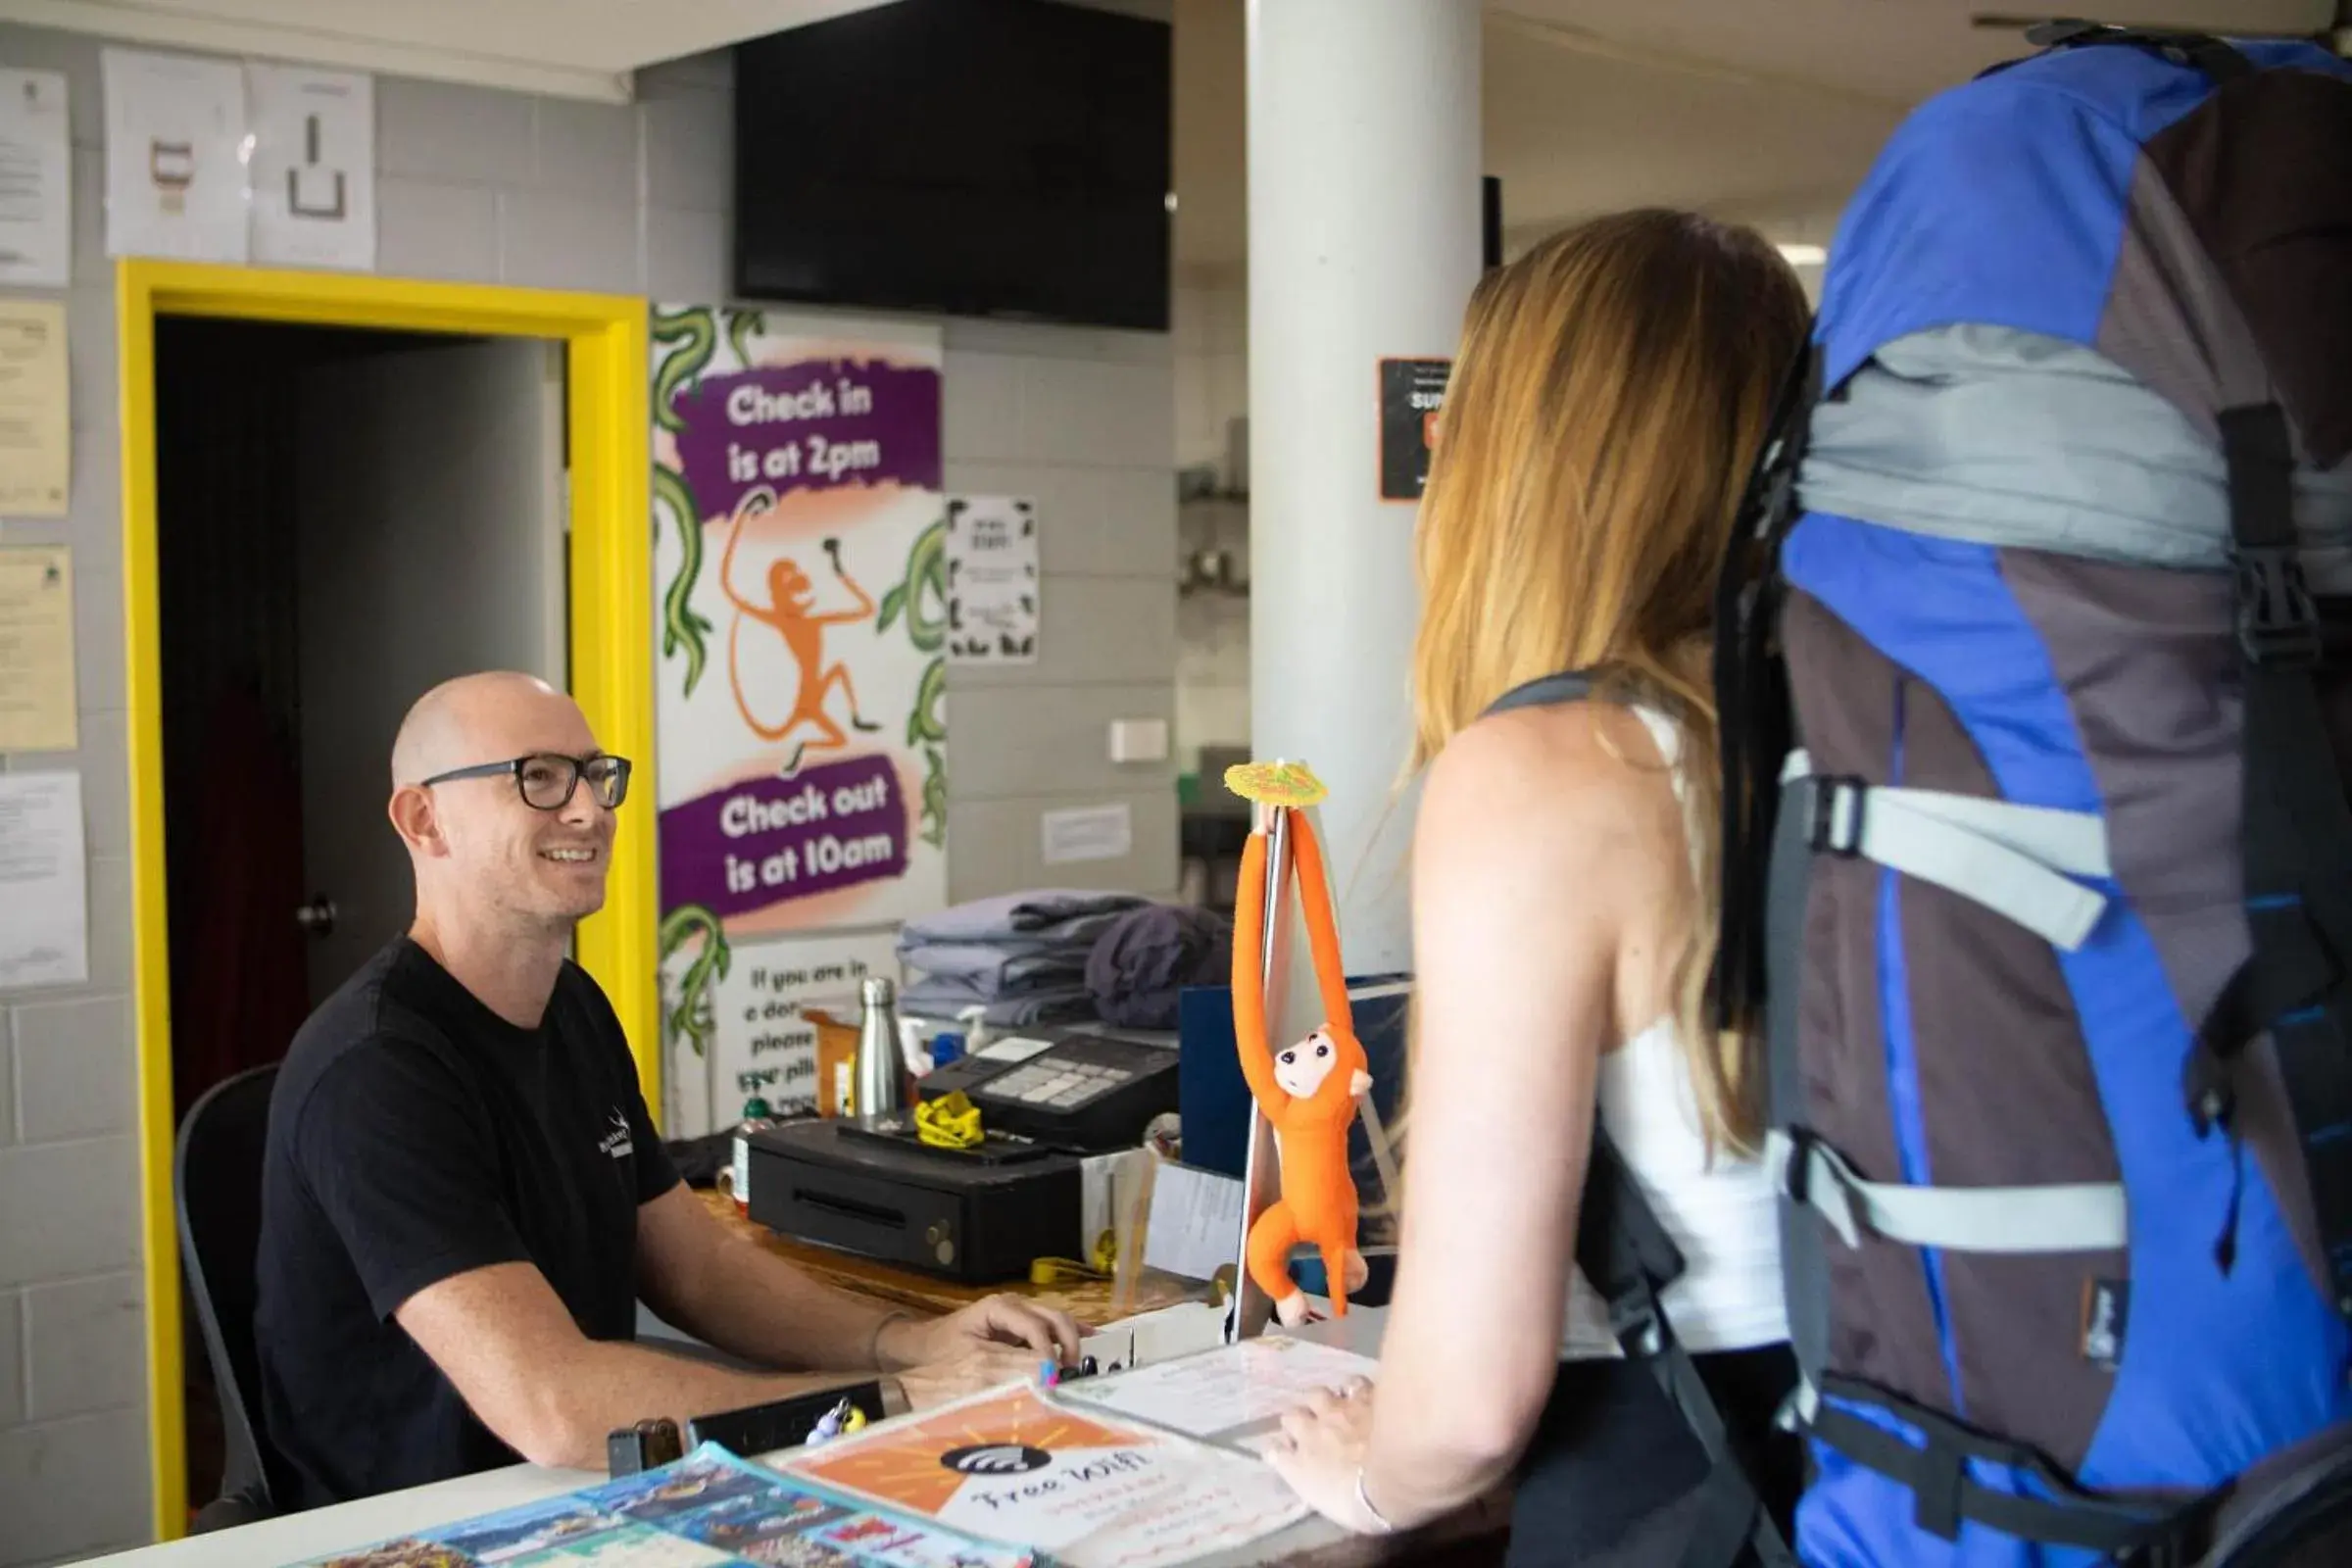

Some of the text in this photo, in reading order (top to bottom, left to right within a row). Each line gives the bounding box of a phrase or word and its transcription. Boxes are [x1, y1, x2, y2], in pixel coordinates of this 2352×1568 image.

[727, 377, 873, 425] Check in
[727, 433, 880, 482] is at 2pm
[720, 774, 888, 838] Check out
[725, 835, 893, 893] is at 10am
[771, 970, 808, 993] you
[812, 965, 845, 981] are
[850, 958, 868, 977] in
[763, 1001, 801, 1019] dor
[751, 1031, 813, 1057] please
[786, 1056, 814, 1083] pill
[970, 1479, 1061, 1510] Free
